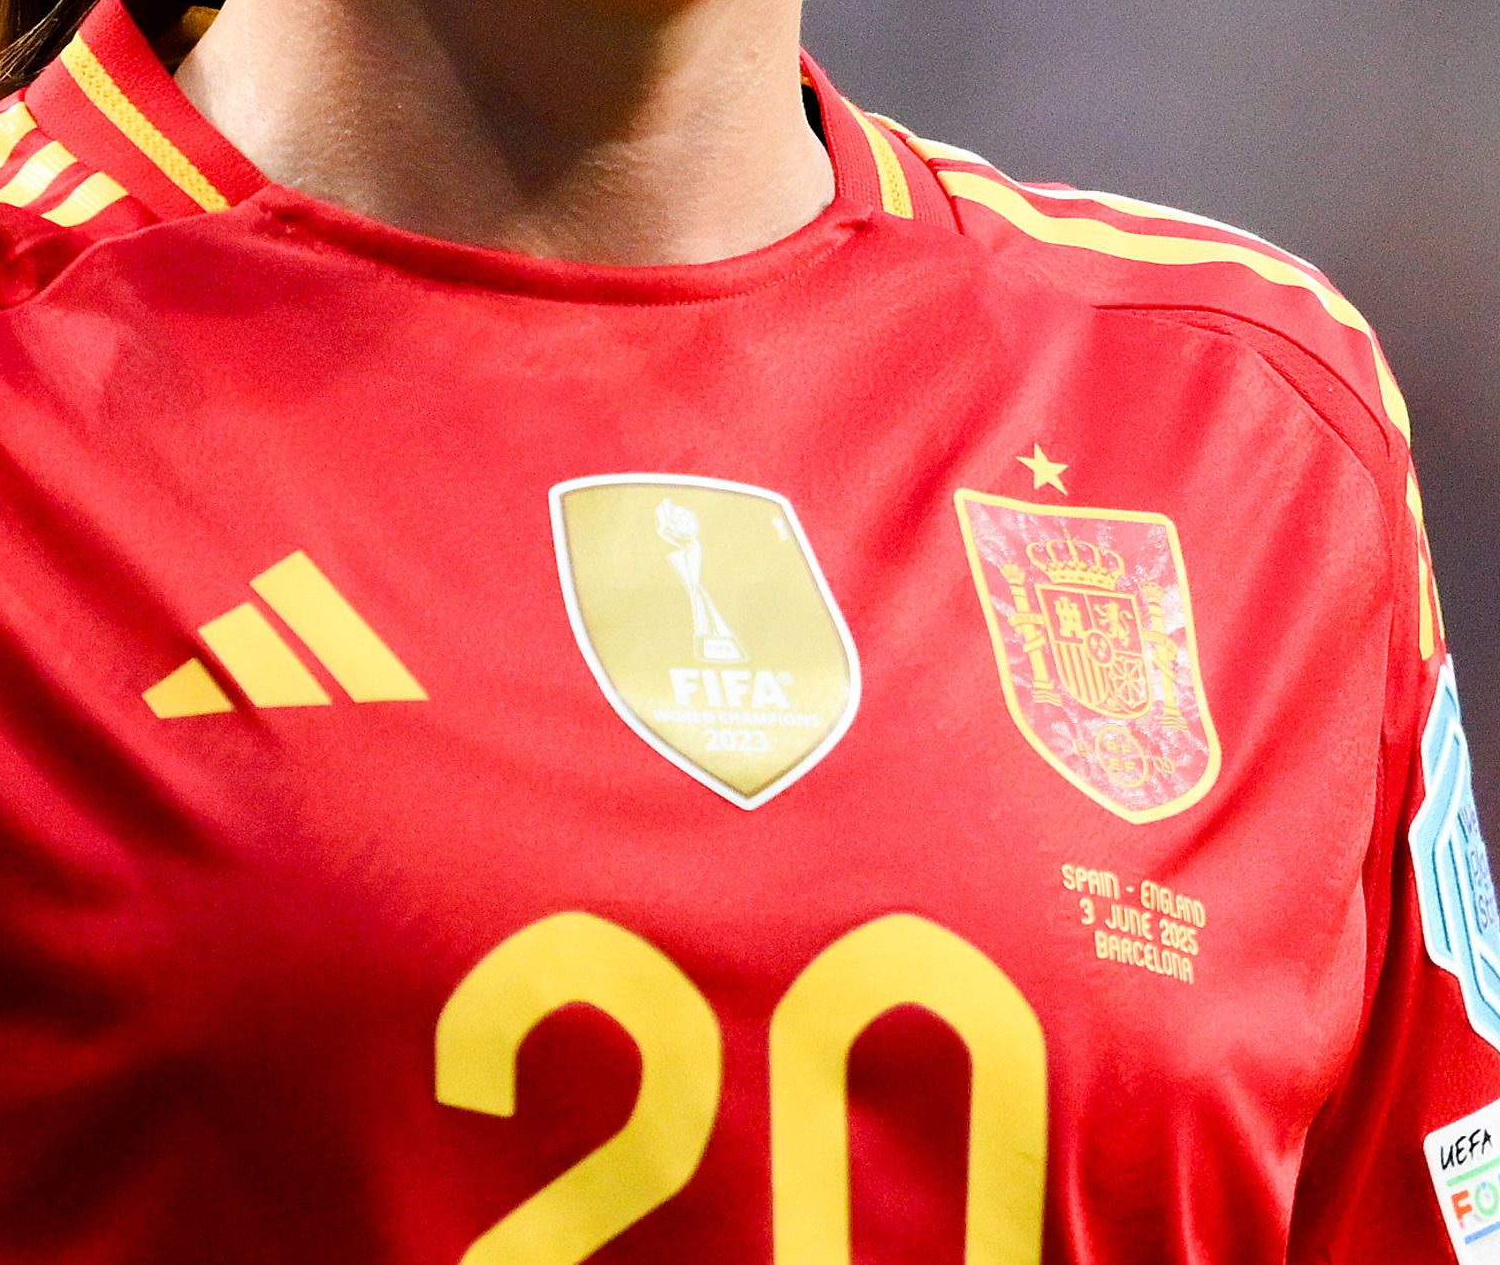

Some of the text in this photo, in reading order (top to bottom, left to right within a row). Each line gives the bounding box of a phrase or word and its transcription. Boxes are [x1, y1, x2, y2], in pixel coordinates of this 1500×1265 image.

[1061, 864, 1120, 900] SPAIN
[1140, 880, 1206, 928] ENGLAND
[1079, 897, 1199, 956] 3 JUNE 2025
[1094, 930, 1195, 985] BARCELONA
[435, 910, 1049, 1265] 20
[1439, 1128, 1493, 1171] UEFA
